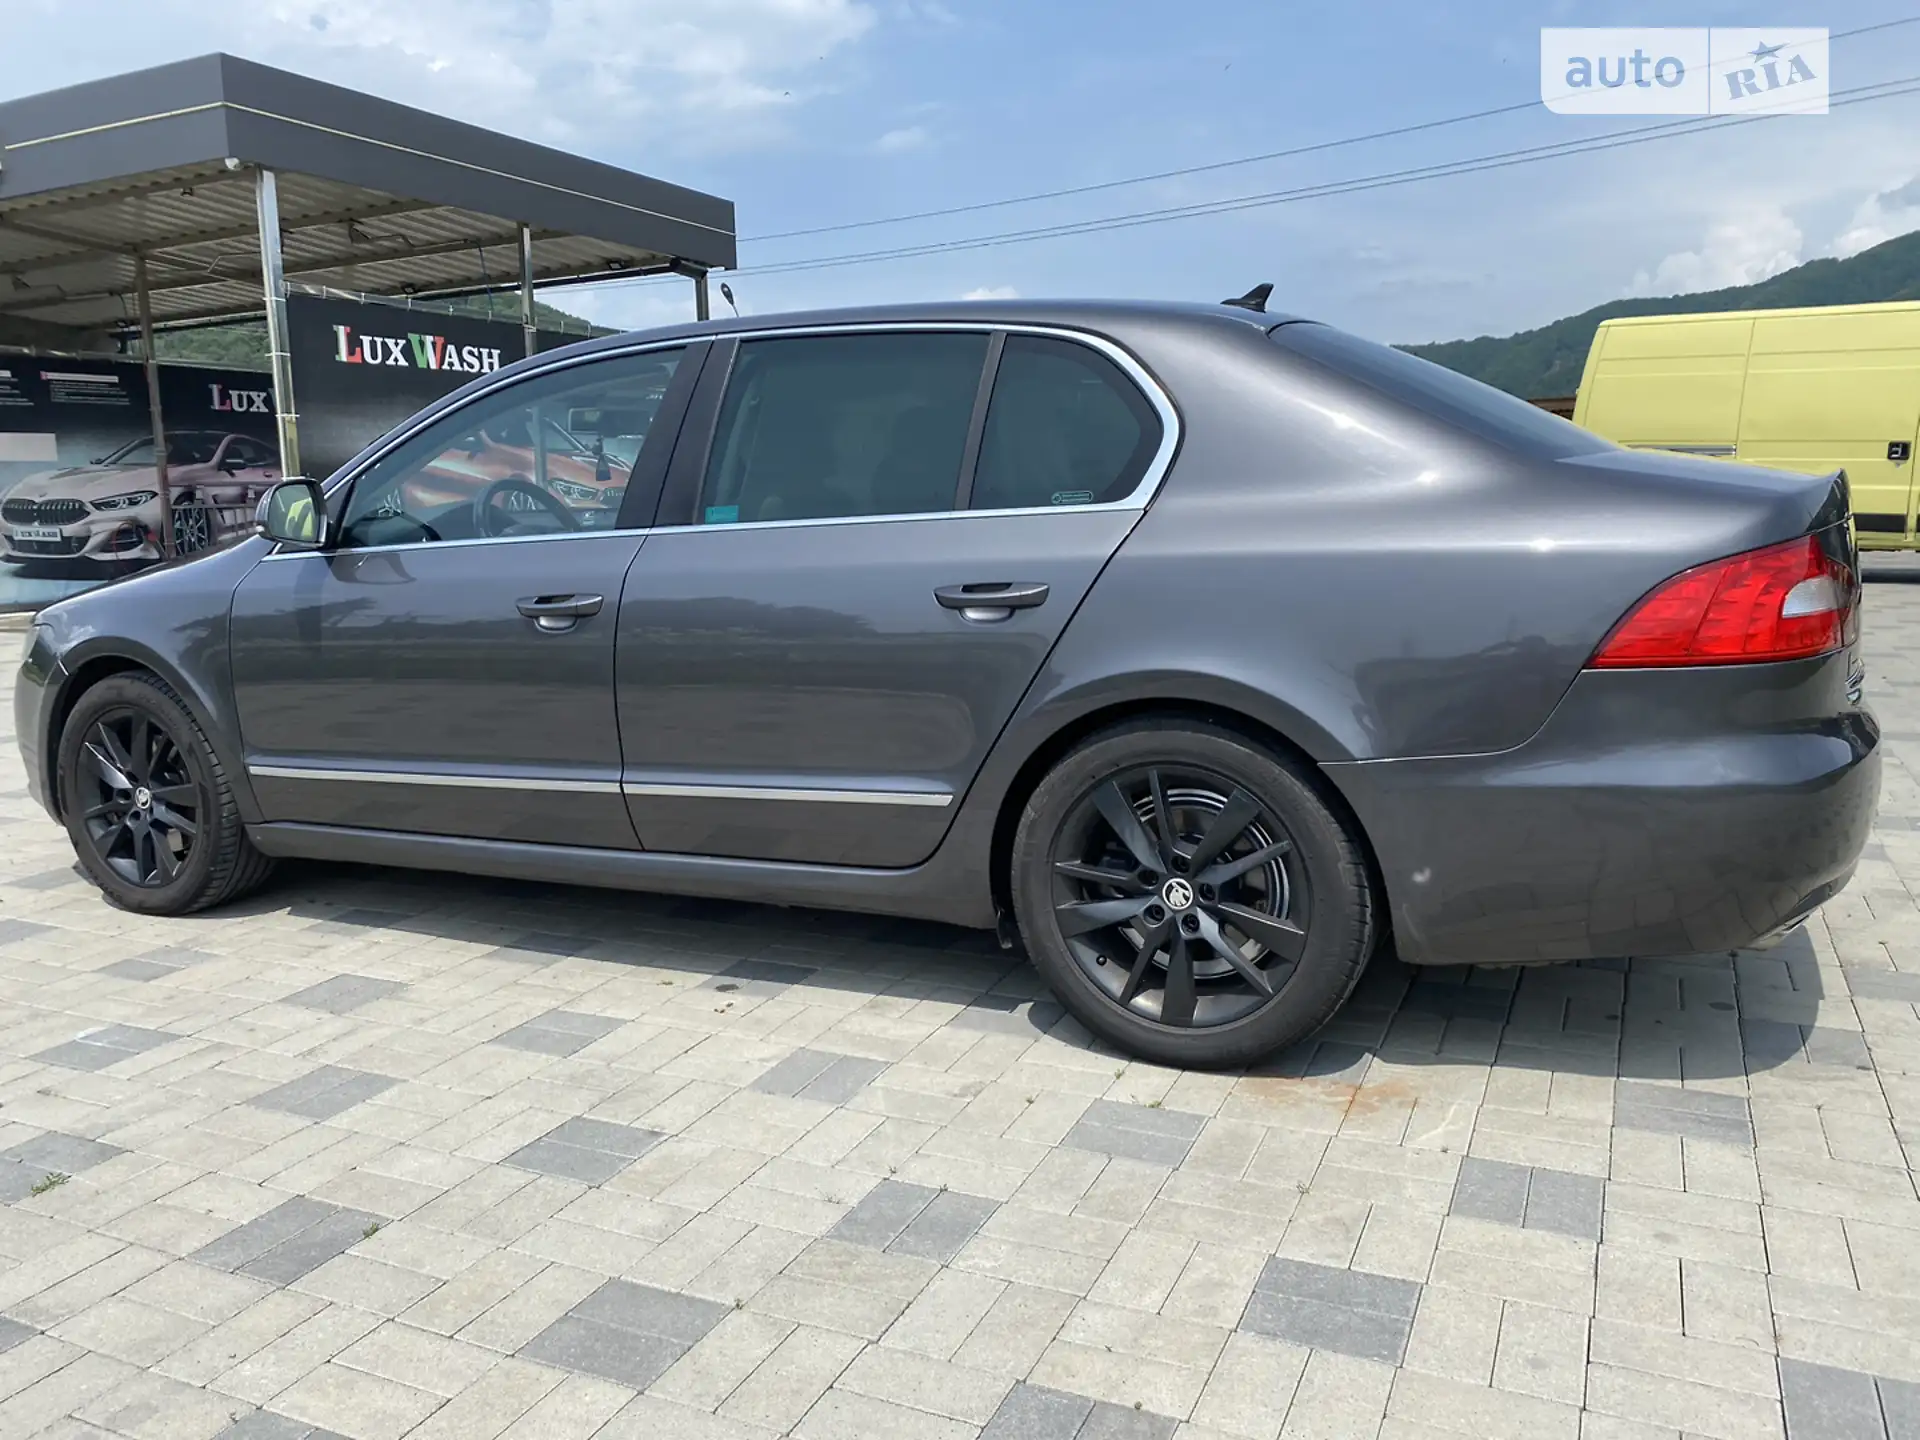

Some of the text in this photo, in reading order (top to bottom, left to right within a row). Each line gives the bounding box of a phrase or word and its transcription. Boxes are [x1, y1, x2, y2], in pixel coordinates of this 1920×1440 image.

[332, 324, 501, 373] LUX WASH
[208, 383, 269, 413] LUX
